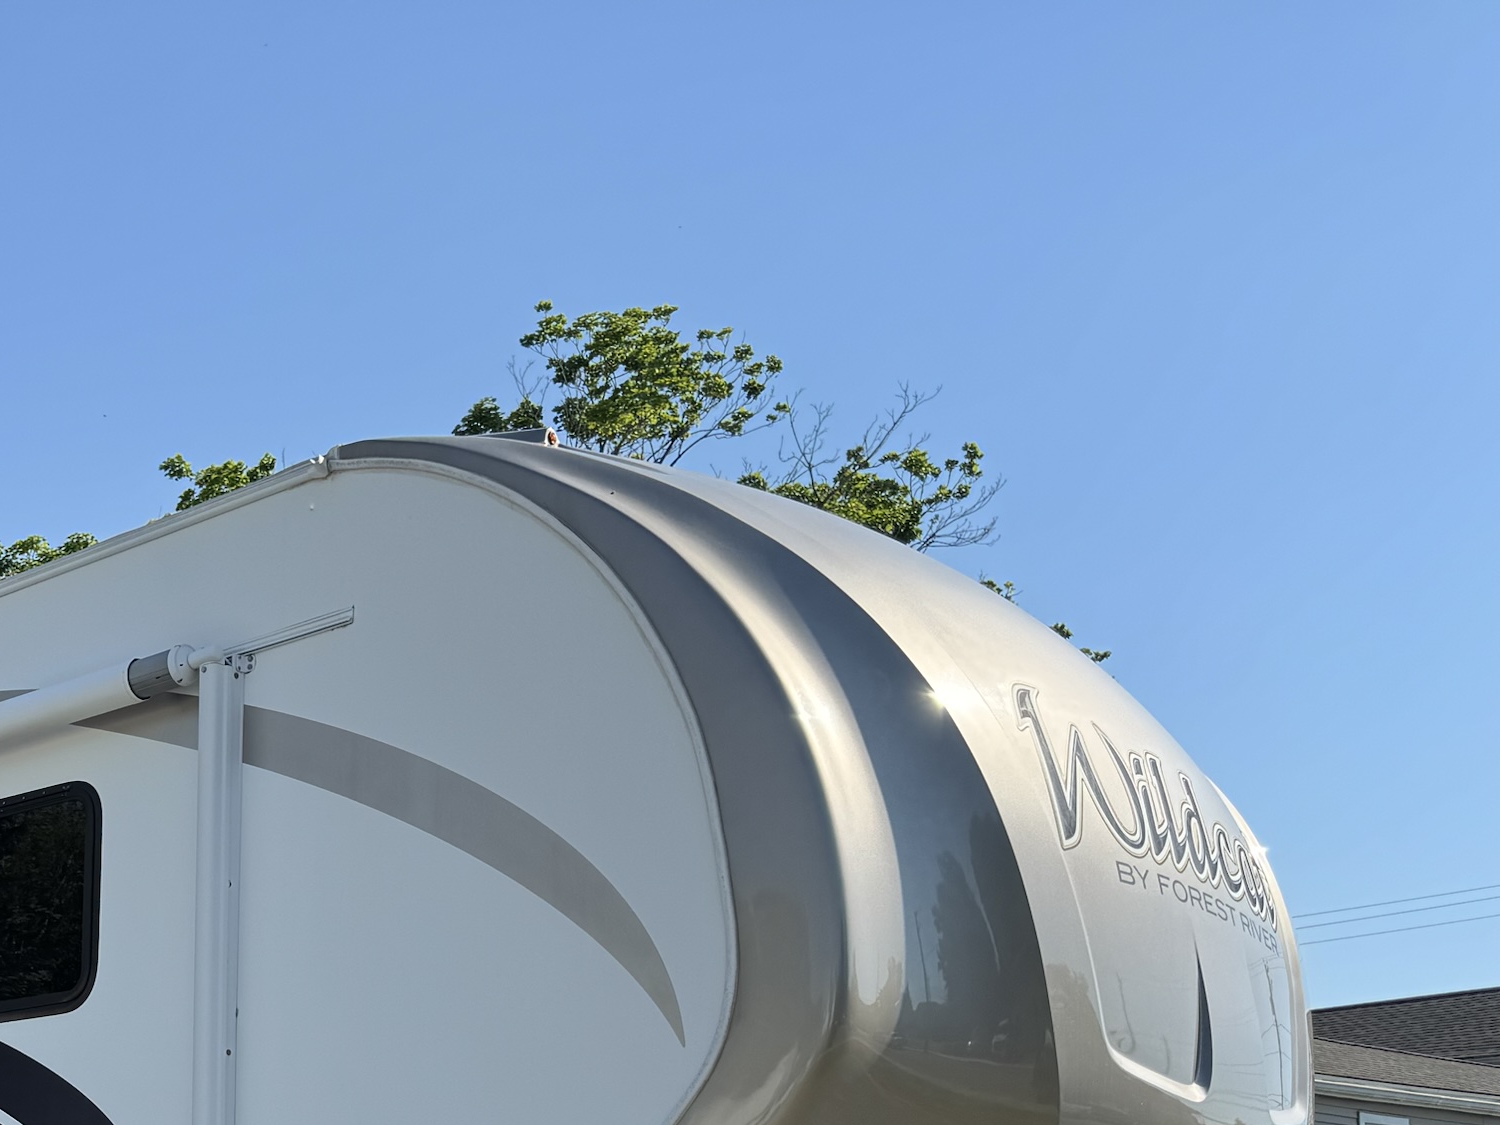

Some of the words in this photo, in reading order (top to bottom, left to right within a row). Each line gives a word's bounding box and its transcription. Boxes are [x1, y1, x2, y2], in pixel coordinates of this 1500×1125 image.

[1115, 860, 1149, 890] BY
[1156, 873, 1236, 927] FOREST
[1239, 911, 1280, 957] RIVER
